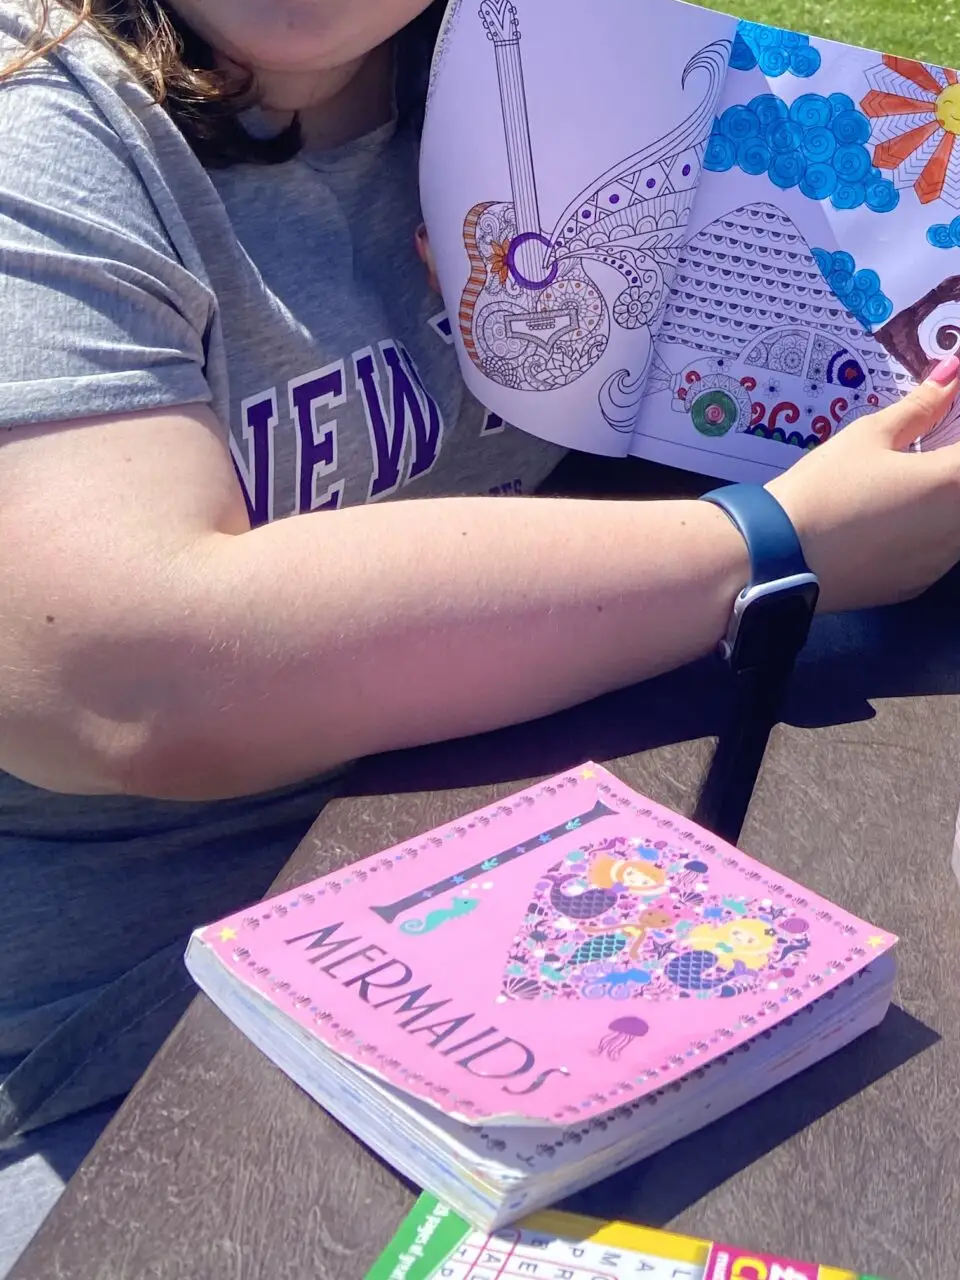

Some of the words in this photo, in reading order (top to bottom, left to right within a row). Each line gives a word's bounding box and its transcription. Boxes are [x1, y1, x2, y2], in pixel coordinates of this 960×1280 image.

[229, 339, 443, 531] NEW
[369, 800, 620, 924] I
[284, 921, 572, 1095] MERMAIDS
